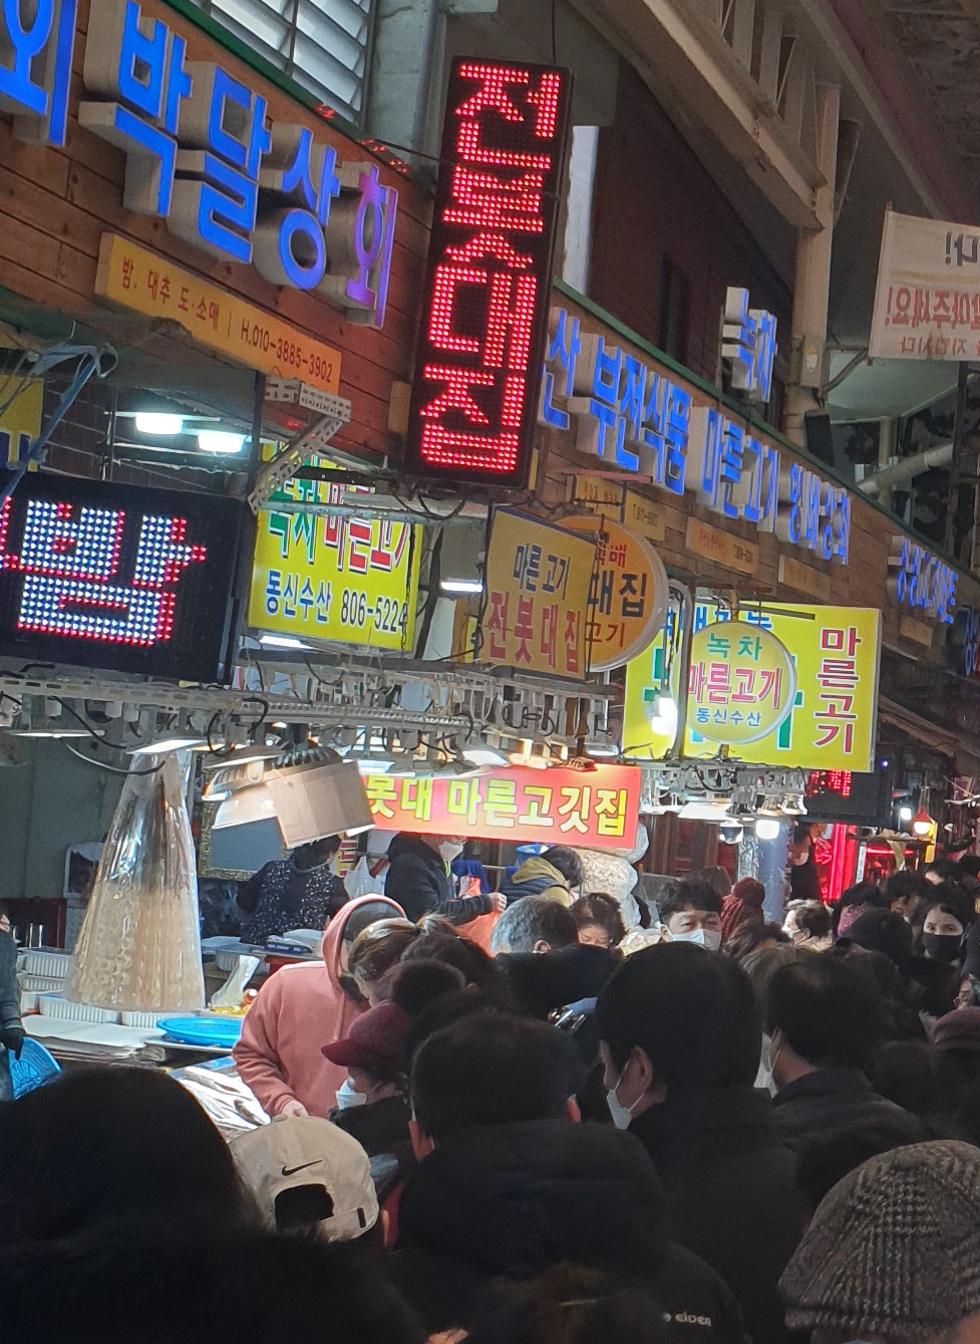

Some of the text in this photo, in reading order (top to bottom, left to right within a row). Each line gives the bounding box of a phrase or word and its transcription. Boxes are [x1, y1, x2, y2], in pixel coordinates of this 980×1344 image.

[118, 1, 398, 329] 박달상회
[147, 269, 172, 306] 대추
[265, 569, 333, 624] 동신수산
[512, 543, 571, 601] 마른고기
[706, 632, 764, 662] 녹차
[687, 660, 783, 711] 마른고기
[813, 627, 862, 754] 마른고기
[696, 706, 763, 728] 동신수산
[447, 777, 628, 837] 마른고깃집
